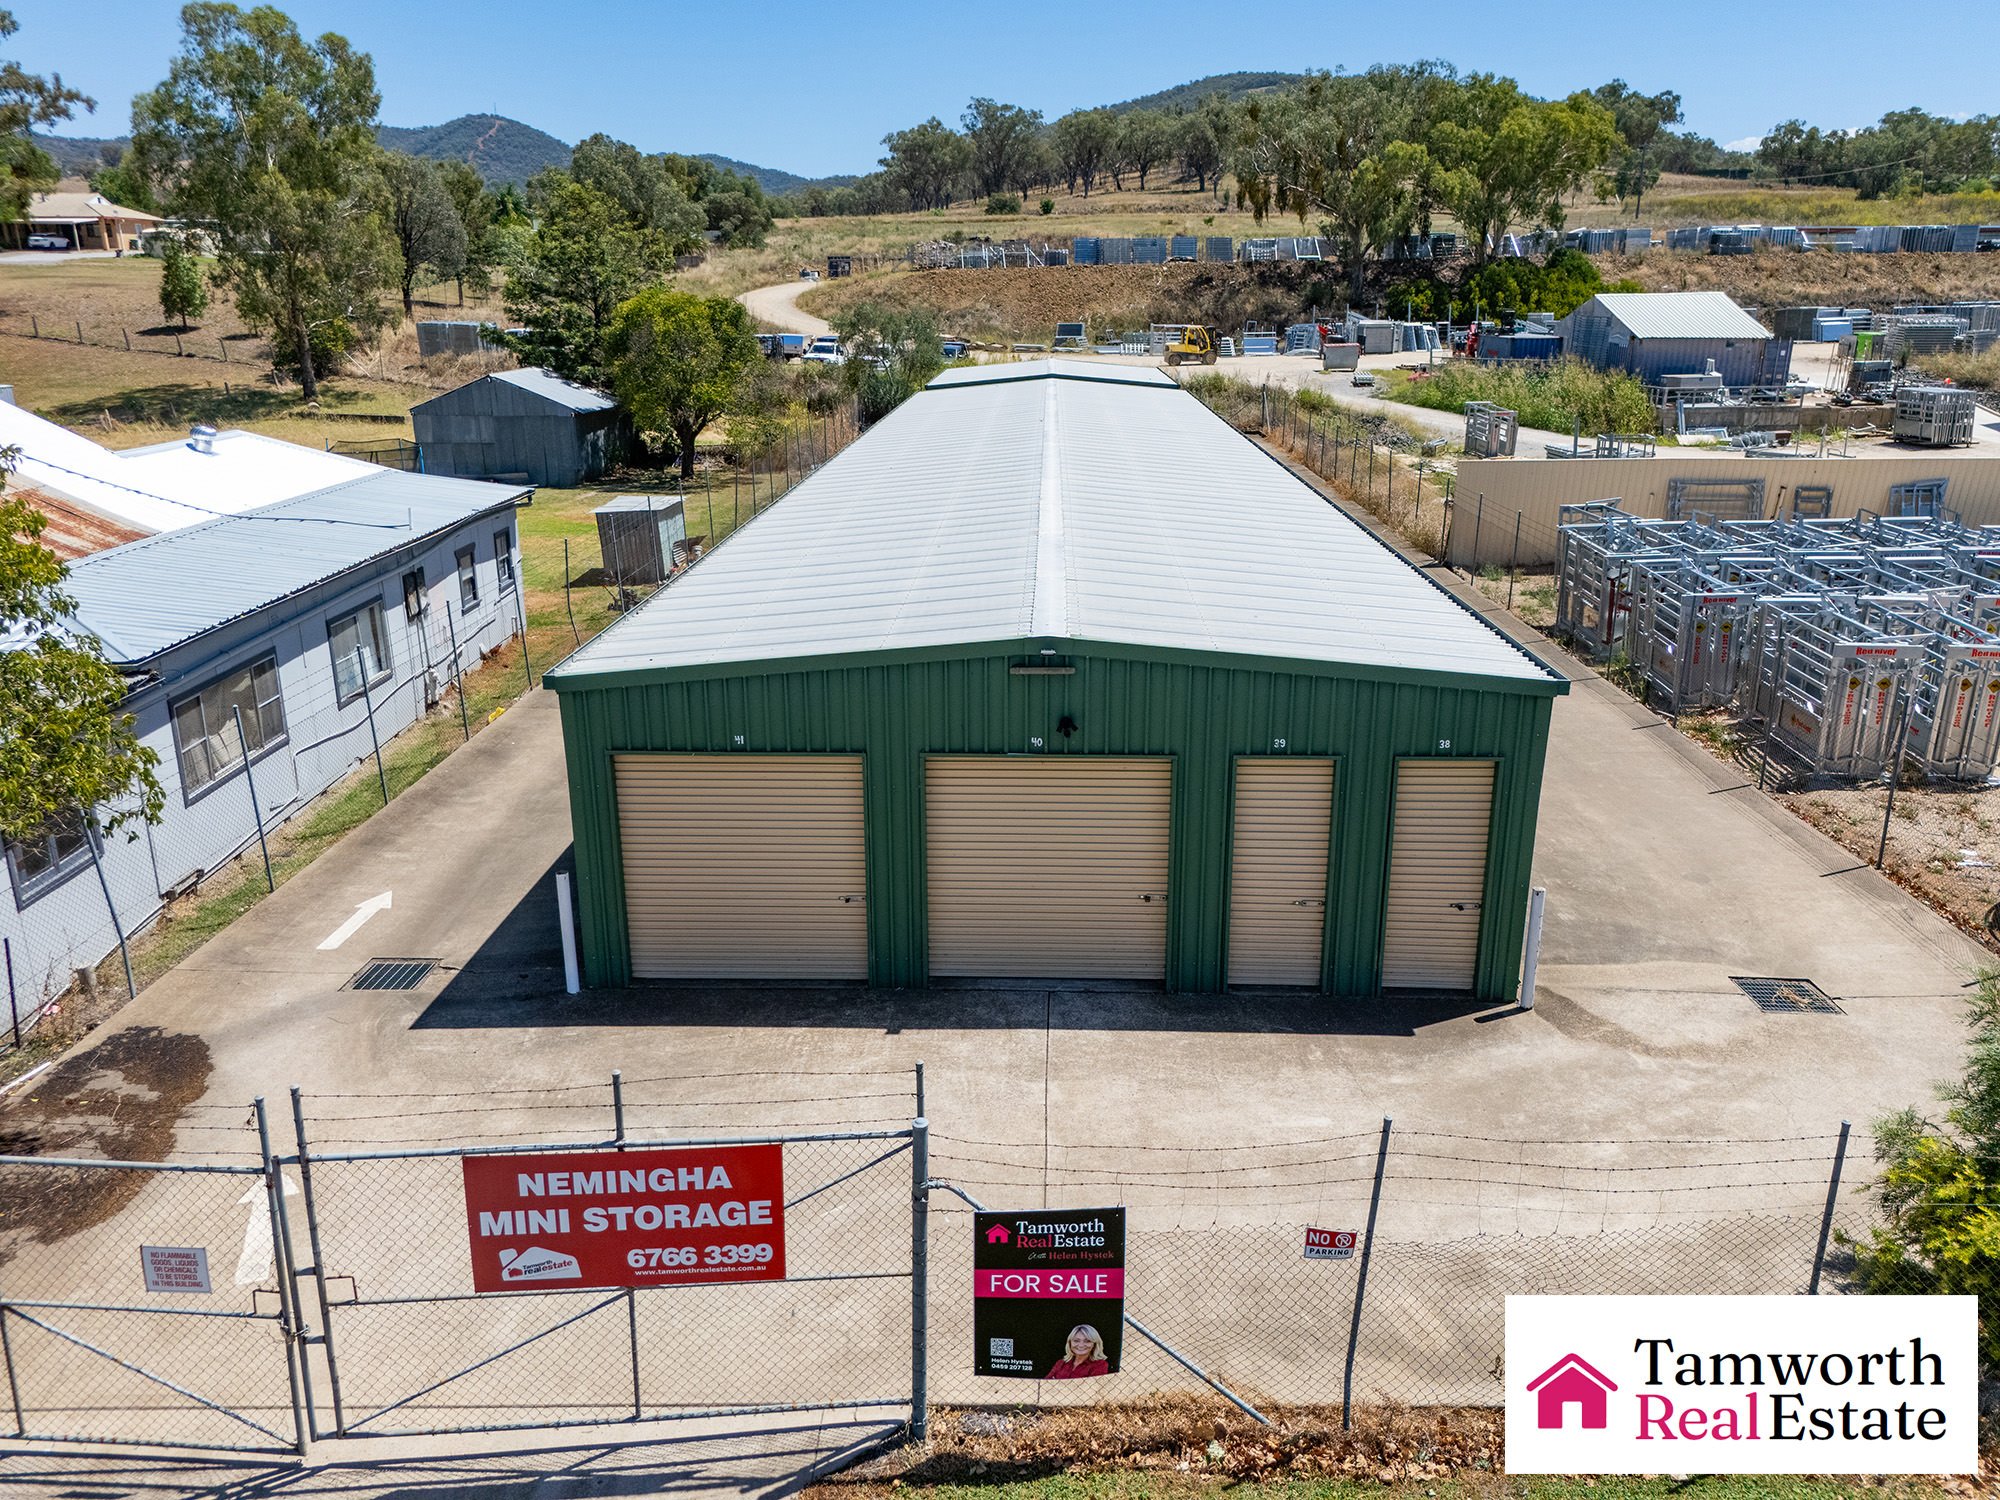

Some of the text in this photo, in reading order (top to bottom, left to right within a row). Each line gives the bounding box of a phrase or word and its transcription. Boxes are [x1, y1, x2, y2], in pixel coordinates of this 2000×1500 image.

[734, 735, 745, 745] 41
[1031, 737, 1043, 747] 40
[1273, 738, 1286, 748] 39
[1439, 739, 1451, 749] 38
[517, 1165, 733, 1197] NEMINGHA
[479, 1200, 773, 1237] MINI STORAGE
[1016, 1218, 1105, 1235] Tamworth
[1308, 1231, 1331, 1245] NO
[150, 1251, 160, 1259] NO
[627, 1243, 774, 1268] 6766 3399
[1049, 1251, 1077, 1260] Helen
[1309, 1247, 1350, 1256] PARKING
[523, 1260, 553, 1270] Tamworth
[634, 1264, 767, 1276] www.tamworthrealestate.com.au
[174, 1273, 198, 1281] STORED
[990, 1274, 1108, 1294] FOR SALE
